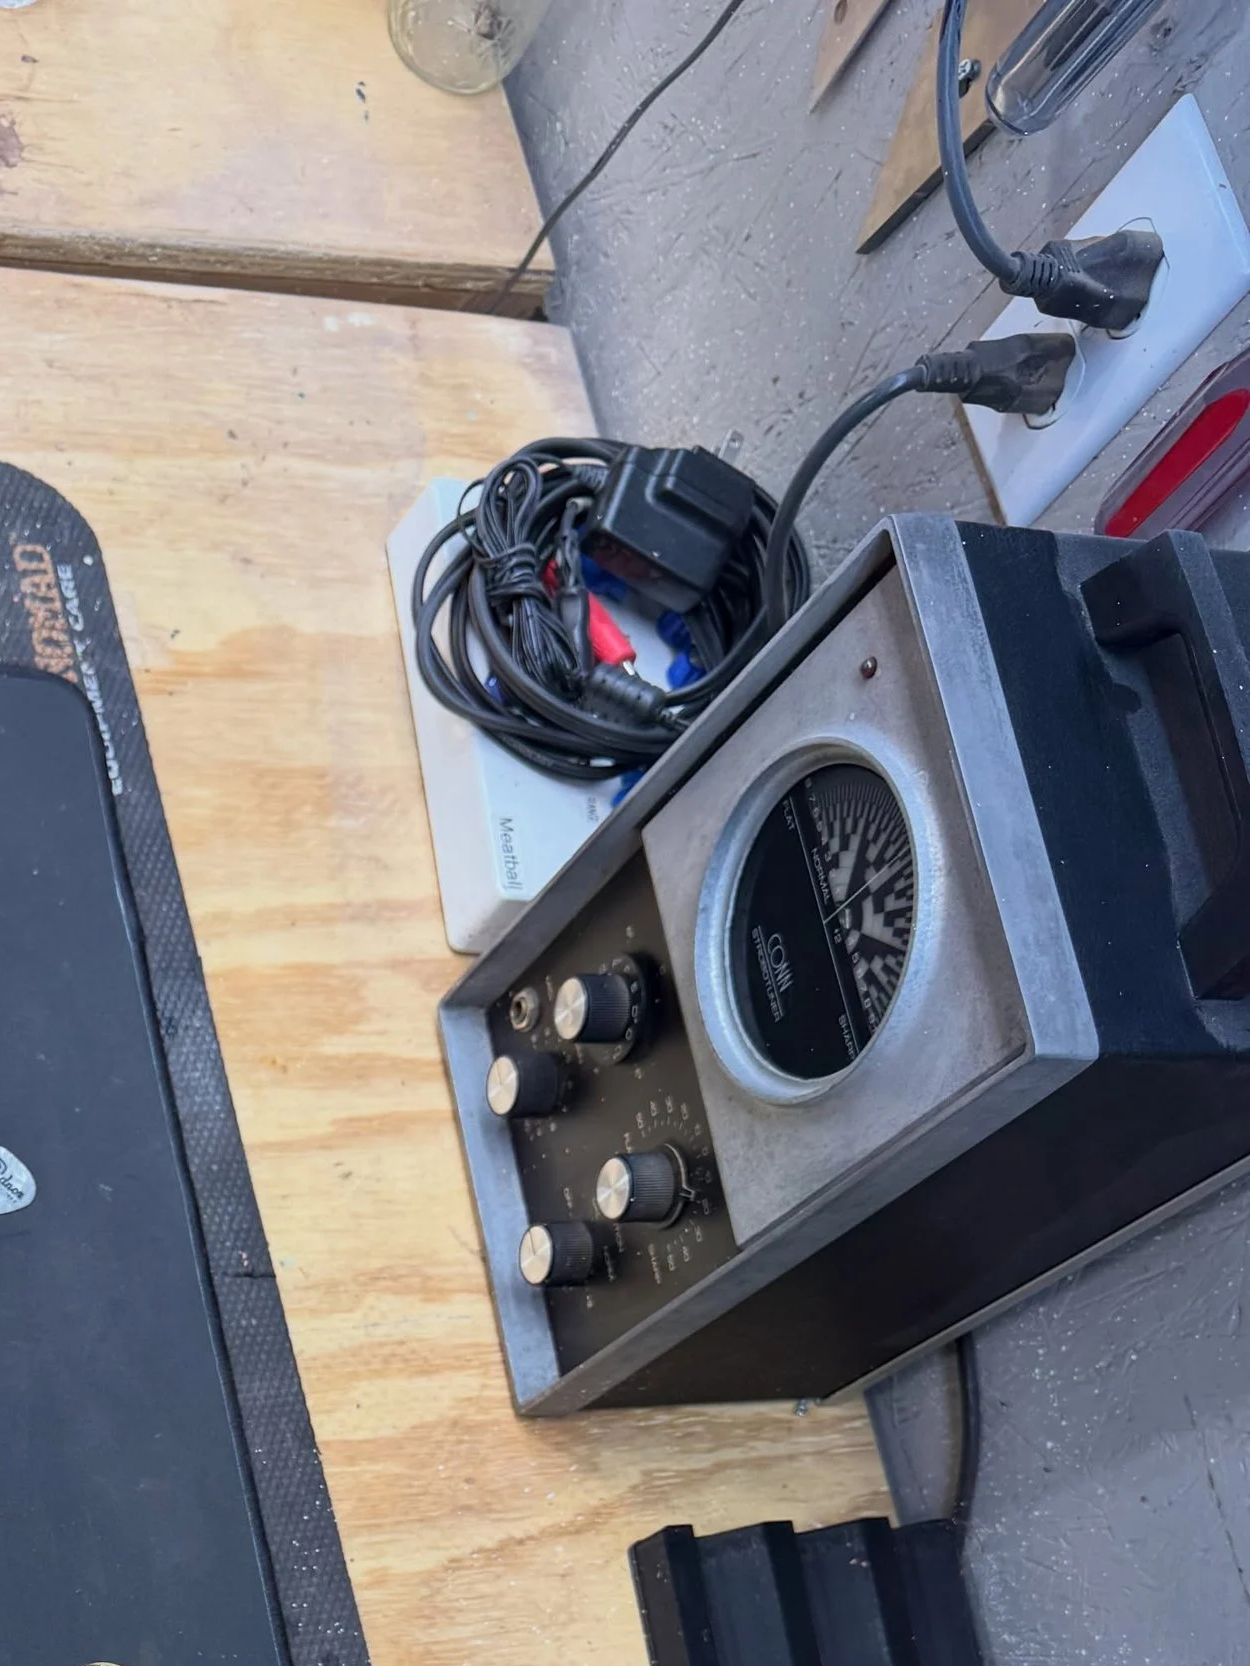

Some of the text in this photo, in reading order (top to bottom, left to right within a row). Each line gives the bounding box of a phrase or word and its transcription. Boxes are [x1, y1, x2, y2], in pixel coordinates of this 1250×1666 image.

[57, 563, 84, 632] CARE
[498, 817, 523, 890] Meatball
[811, 847, 830, 905] NORMAL
[751, 927, 781, 1022] STROBOTUNER
[767, 933, 794, 993] CONN
